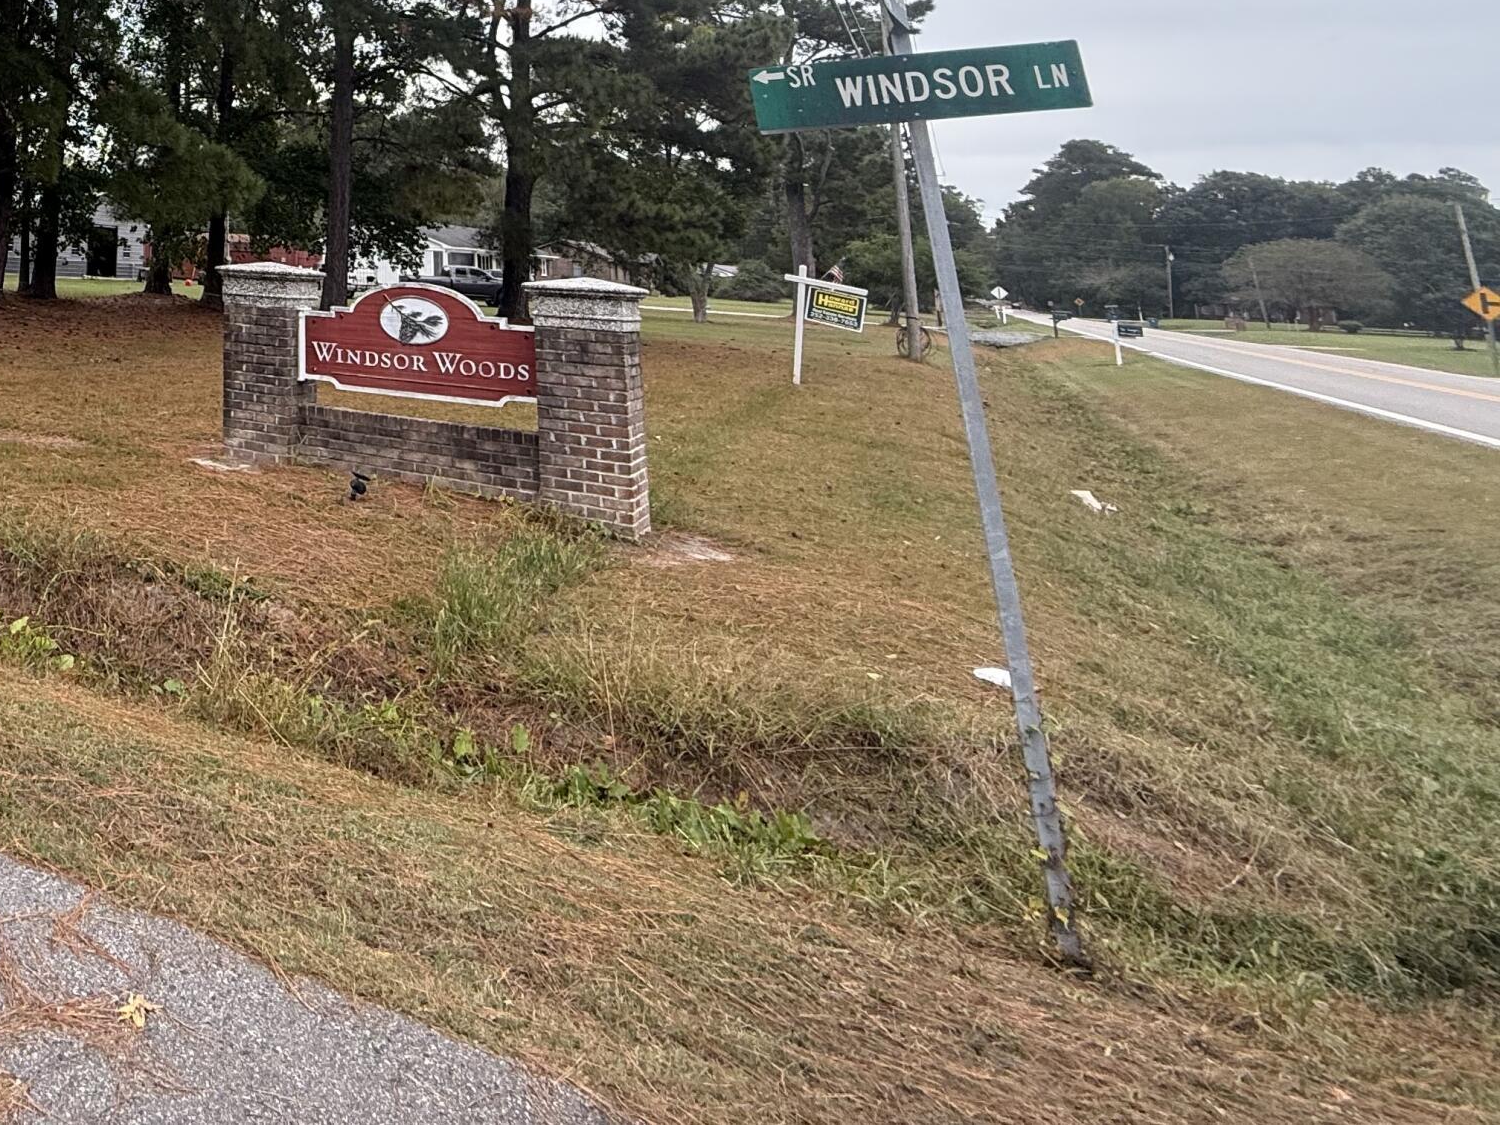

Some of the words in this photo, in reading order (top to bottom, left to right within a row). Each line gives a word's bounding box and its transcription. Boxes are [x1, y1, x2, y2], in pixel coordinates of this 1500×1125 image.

[786, 65, 816, 89] SR
[835, 64, 1016, 109] WINDSOR
[1033, 62, 1070, 90] LN
